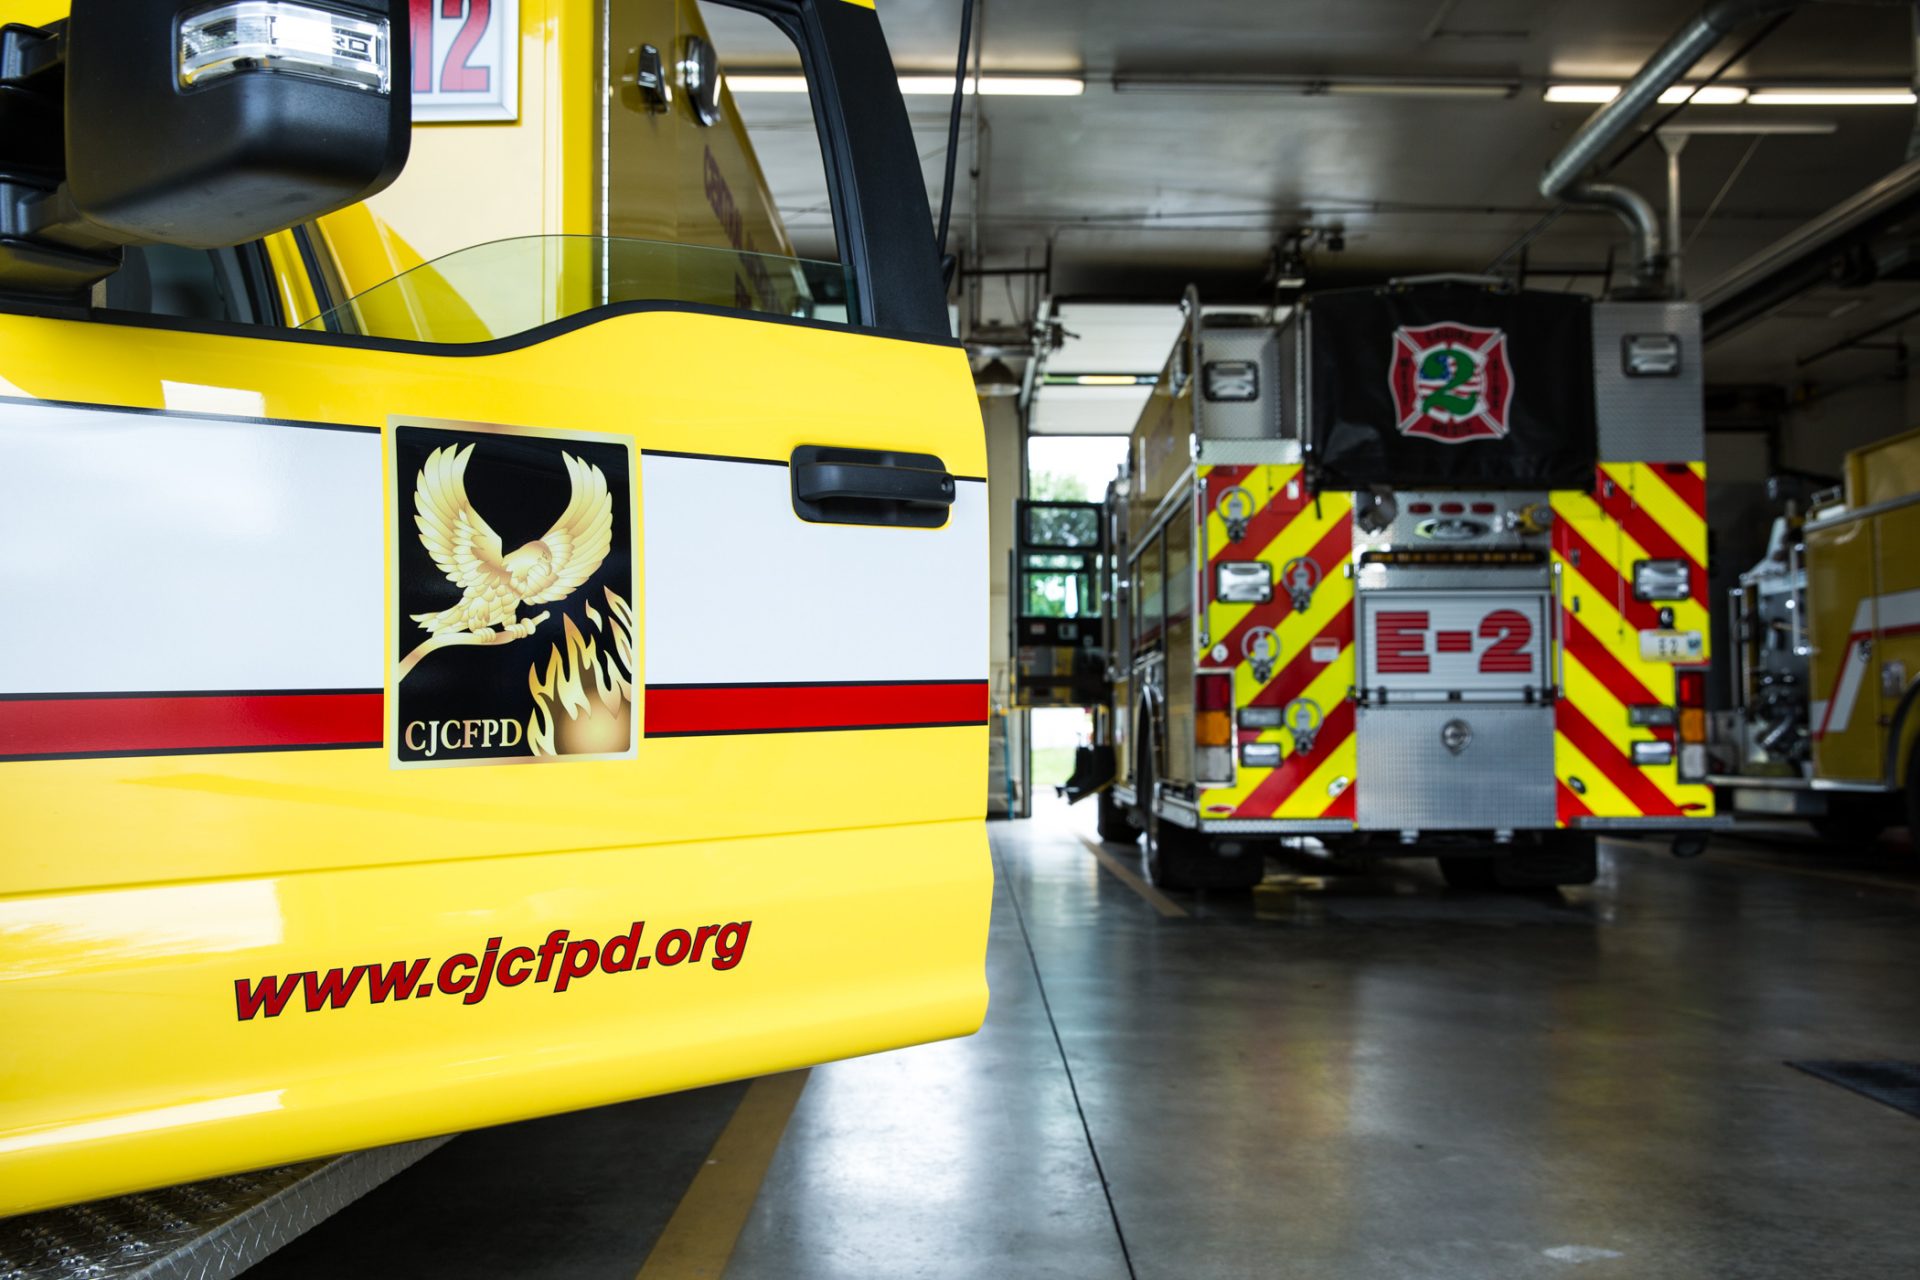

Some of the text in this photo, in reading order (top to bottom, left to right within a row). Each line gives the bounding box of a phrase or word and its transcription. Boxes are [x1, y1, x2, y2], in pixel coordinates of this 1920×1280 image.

[1420, 348, 1477, 416] 2
[1376, 609, 1532, 673] E-2
[404, 718, 523, 757] CJCFPD
[234, 920, 752, 1021] www.cjcfpd.org
